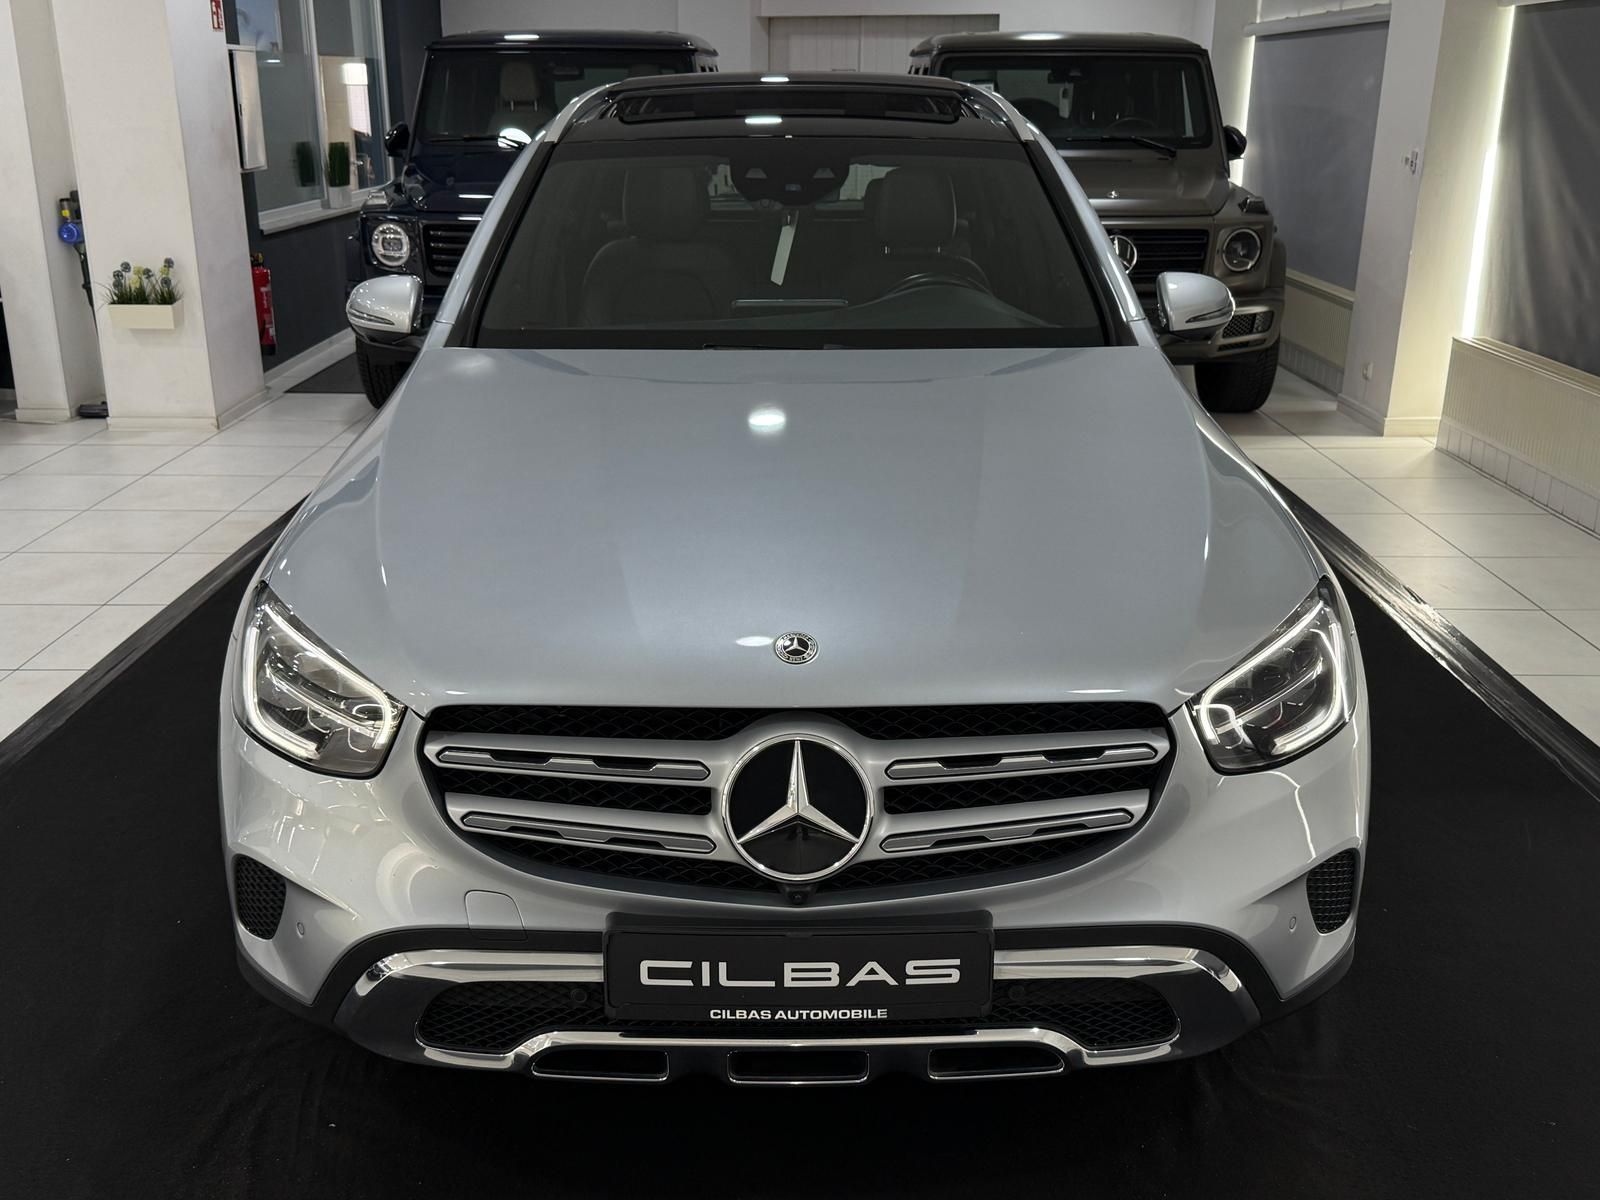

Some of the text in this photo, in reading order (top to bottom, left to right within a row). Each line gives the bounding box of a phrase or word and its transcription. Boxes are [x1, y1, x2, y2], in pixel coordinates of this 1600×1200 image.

[639, 958, 962, 988] CILBAS
[709, 1008, 888, 1020] CILBAS AUTOMOBILE
